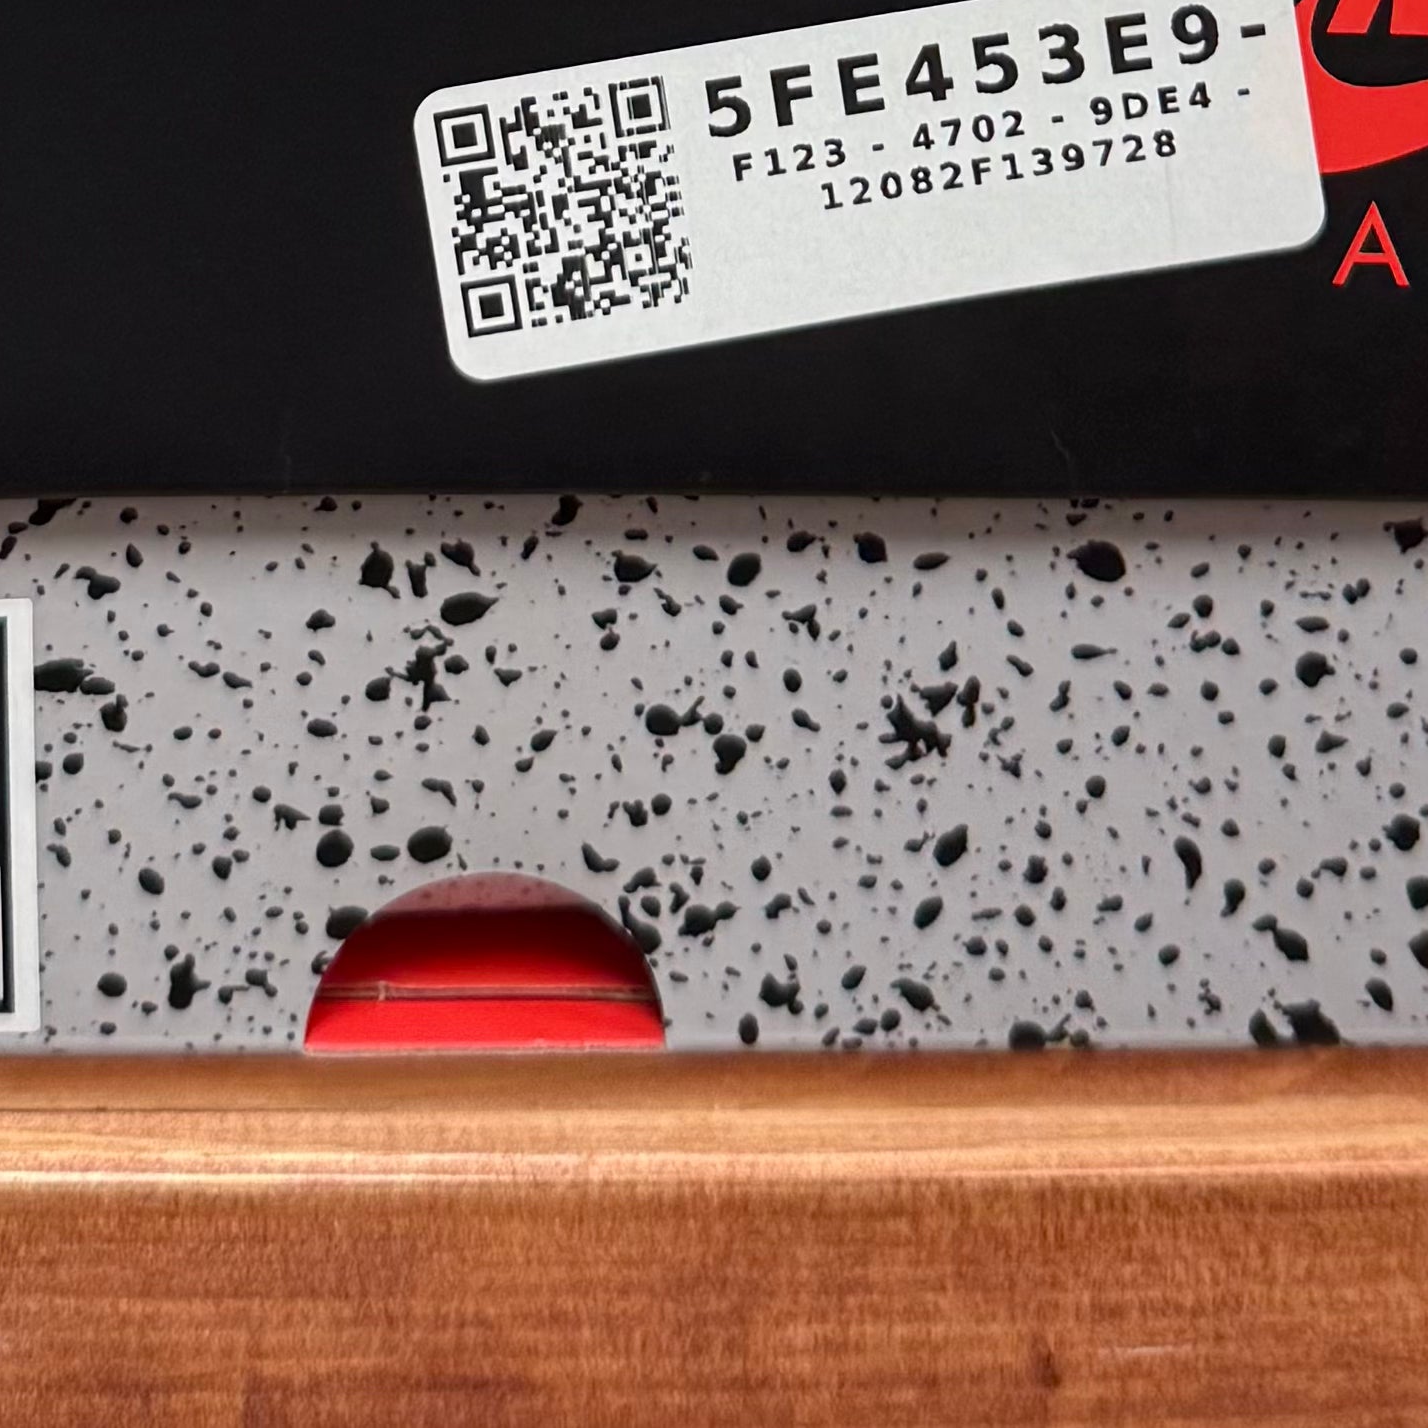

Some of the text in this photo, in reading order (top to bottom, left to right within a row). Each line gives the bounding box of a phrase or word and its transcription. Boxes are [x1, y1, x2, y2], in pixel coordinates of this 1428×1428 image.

[705, 4, 1266, 137] 5FE453E9-
[732, 137, 847, 182] F123
[912, 110, 1025, 151] 4702
[1089, 81, 1212, 126] 9DE4
[821, 129, 1177, 210] 12082F139728
